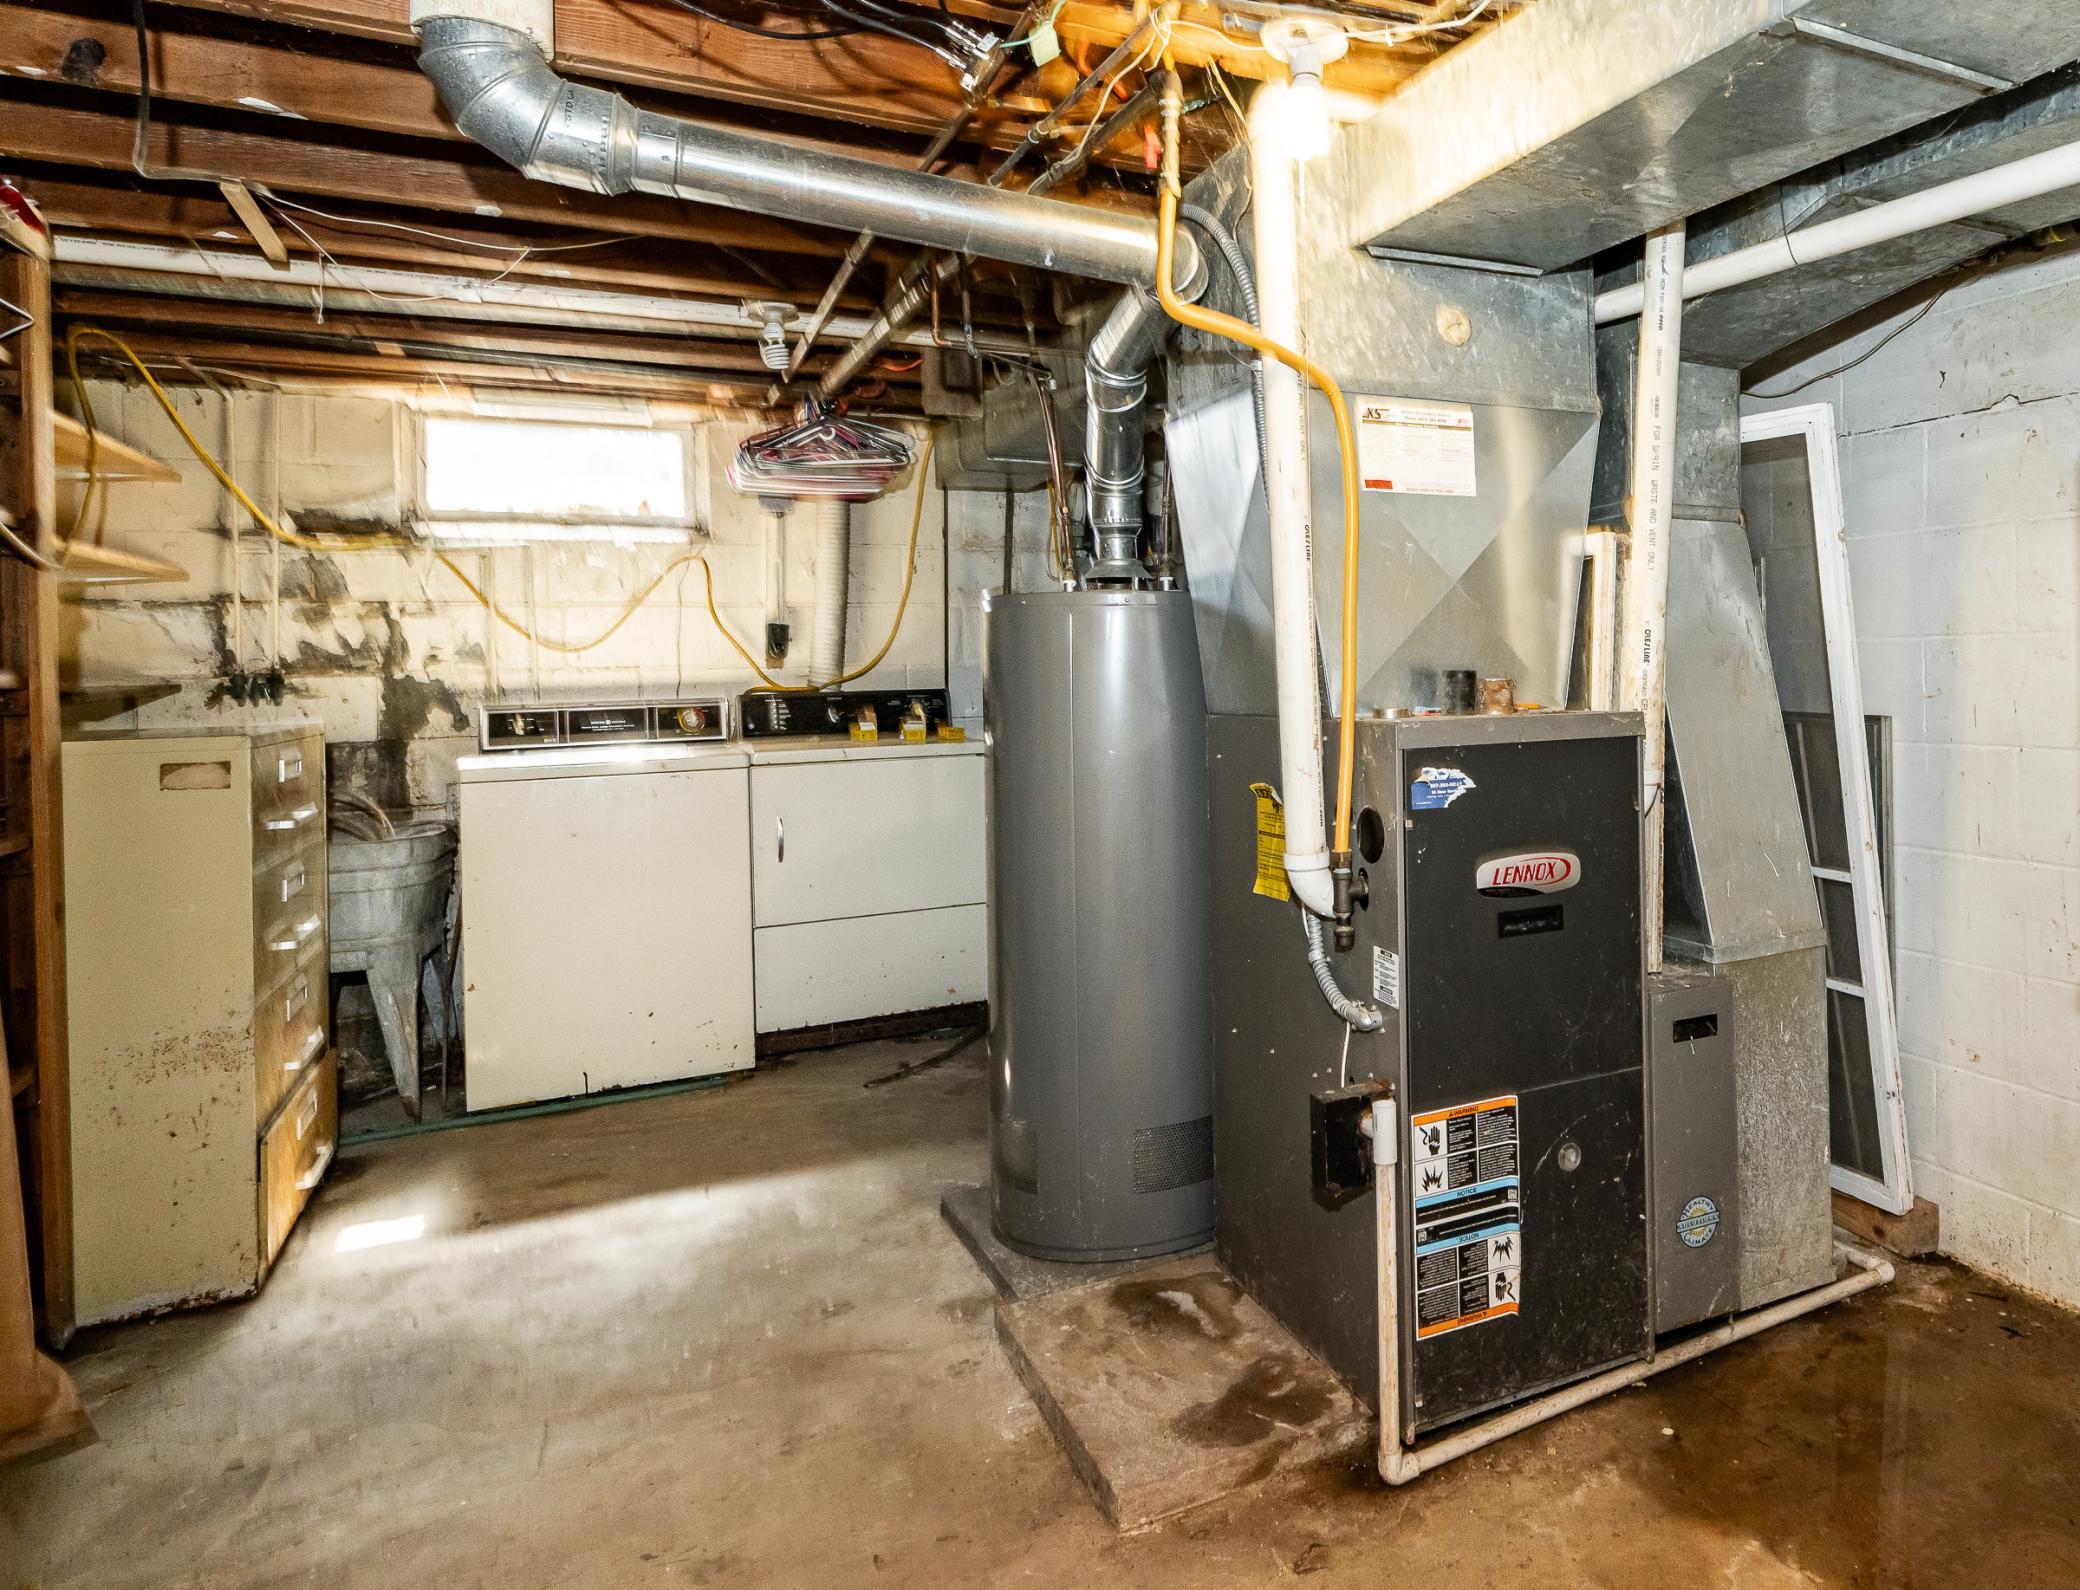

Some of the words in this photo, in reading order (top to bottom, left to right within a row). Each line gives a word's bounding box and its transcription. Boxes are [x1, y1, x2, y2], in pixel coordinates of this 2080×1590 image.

[1650, 479, 1659, 504] WASTE
[1649, 507, 1658, 524] AND
[1648, 527, 1657, 549] VENT
[1647, 551, 1656, 572] ONLY
[1493, 862, 1556, 885] LENNOX
[1453, 1105, 1479, 1116] WARNING
[1456, 1187, 1477, 1197] NOTICE
[1682, 1199, 1714, 1218] HEALTHY
